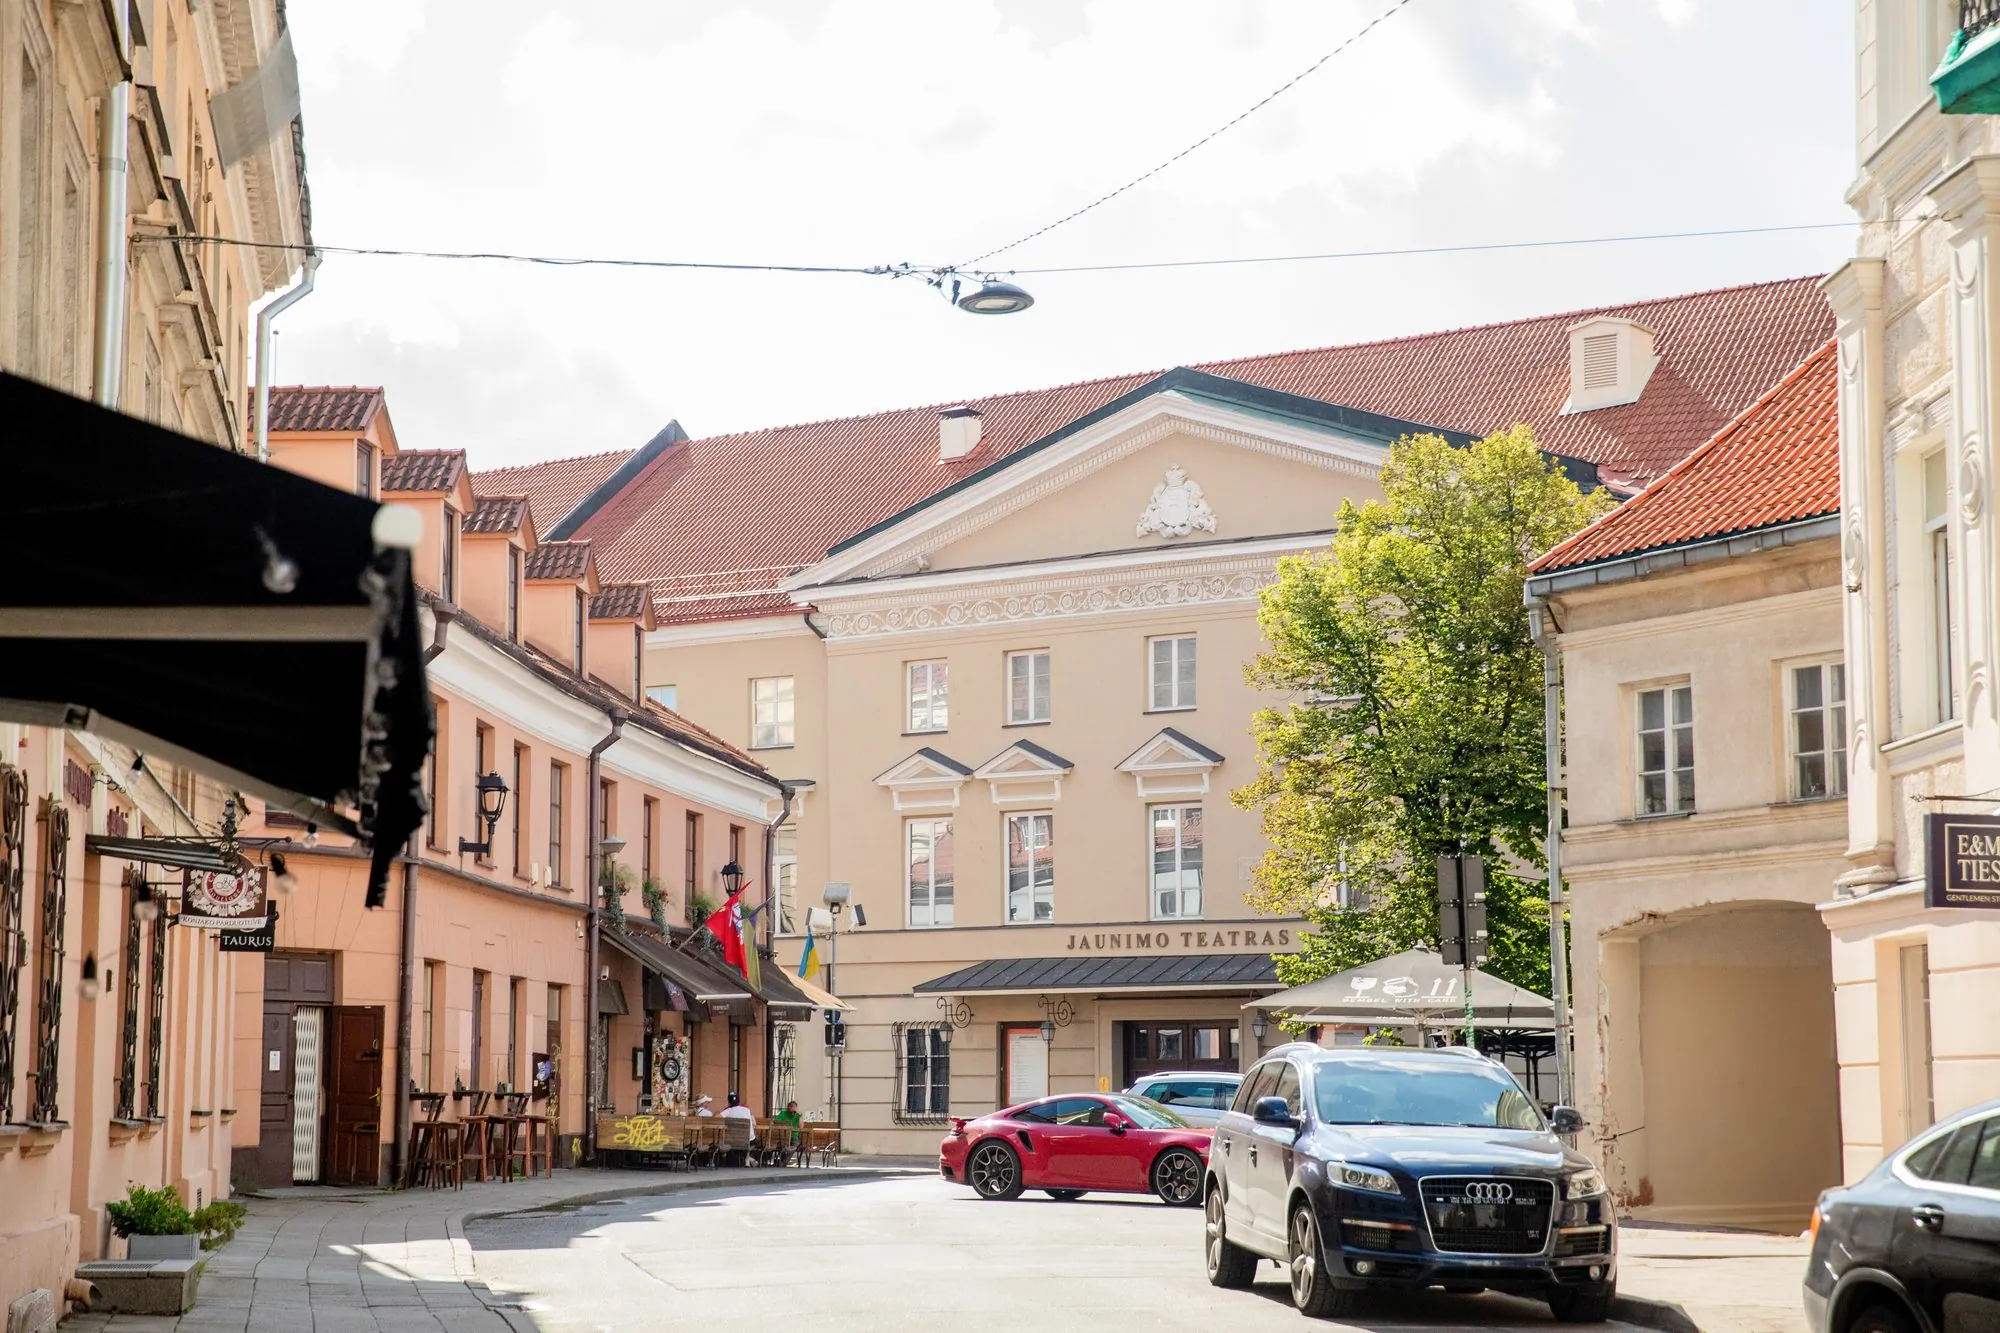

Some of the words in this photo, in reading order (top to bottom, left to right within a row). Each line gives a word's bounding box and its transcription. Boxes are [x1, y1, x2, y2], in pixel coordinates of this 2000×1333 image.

[1956, 834, 2000, 857] E&M
[1957, 859, 2000, 883] TIES
[1946, 894, 1990, 903] GENTLEMEN
[222, 935, 272, 947] TAURUS
[1066, 932, 1170, 950] JAUNIMO
[1180, 929, 1290, 948] TEATRAS
